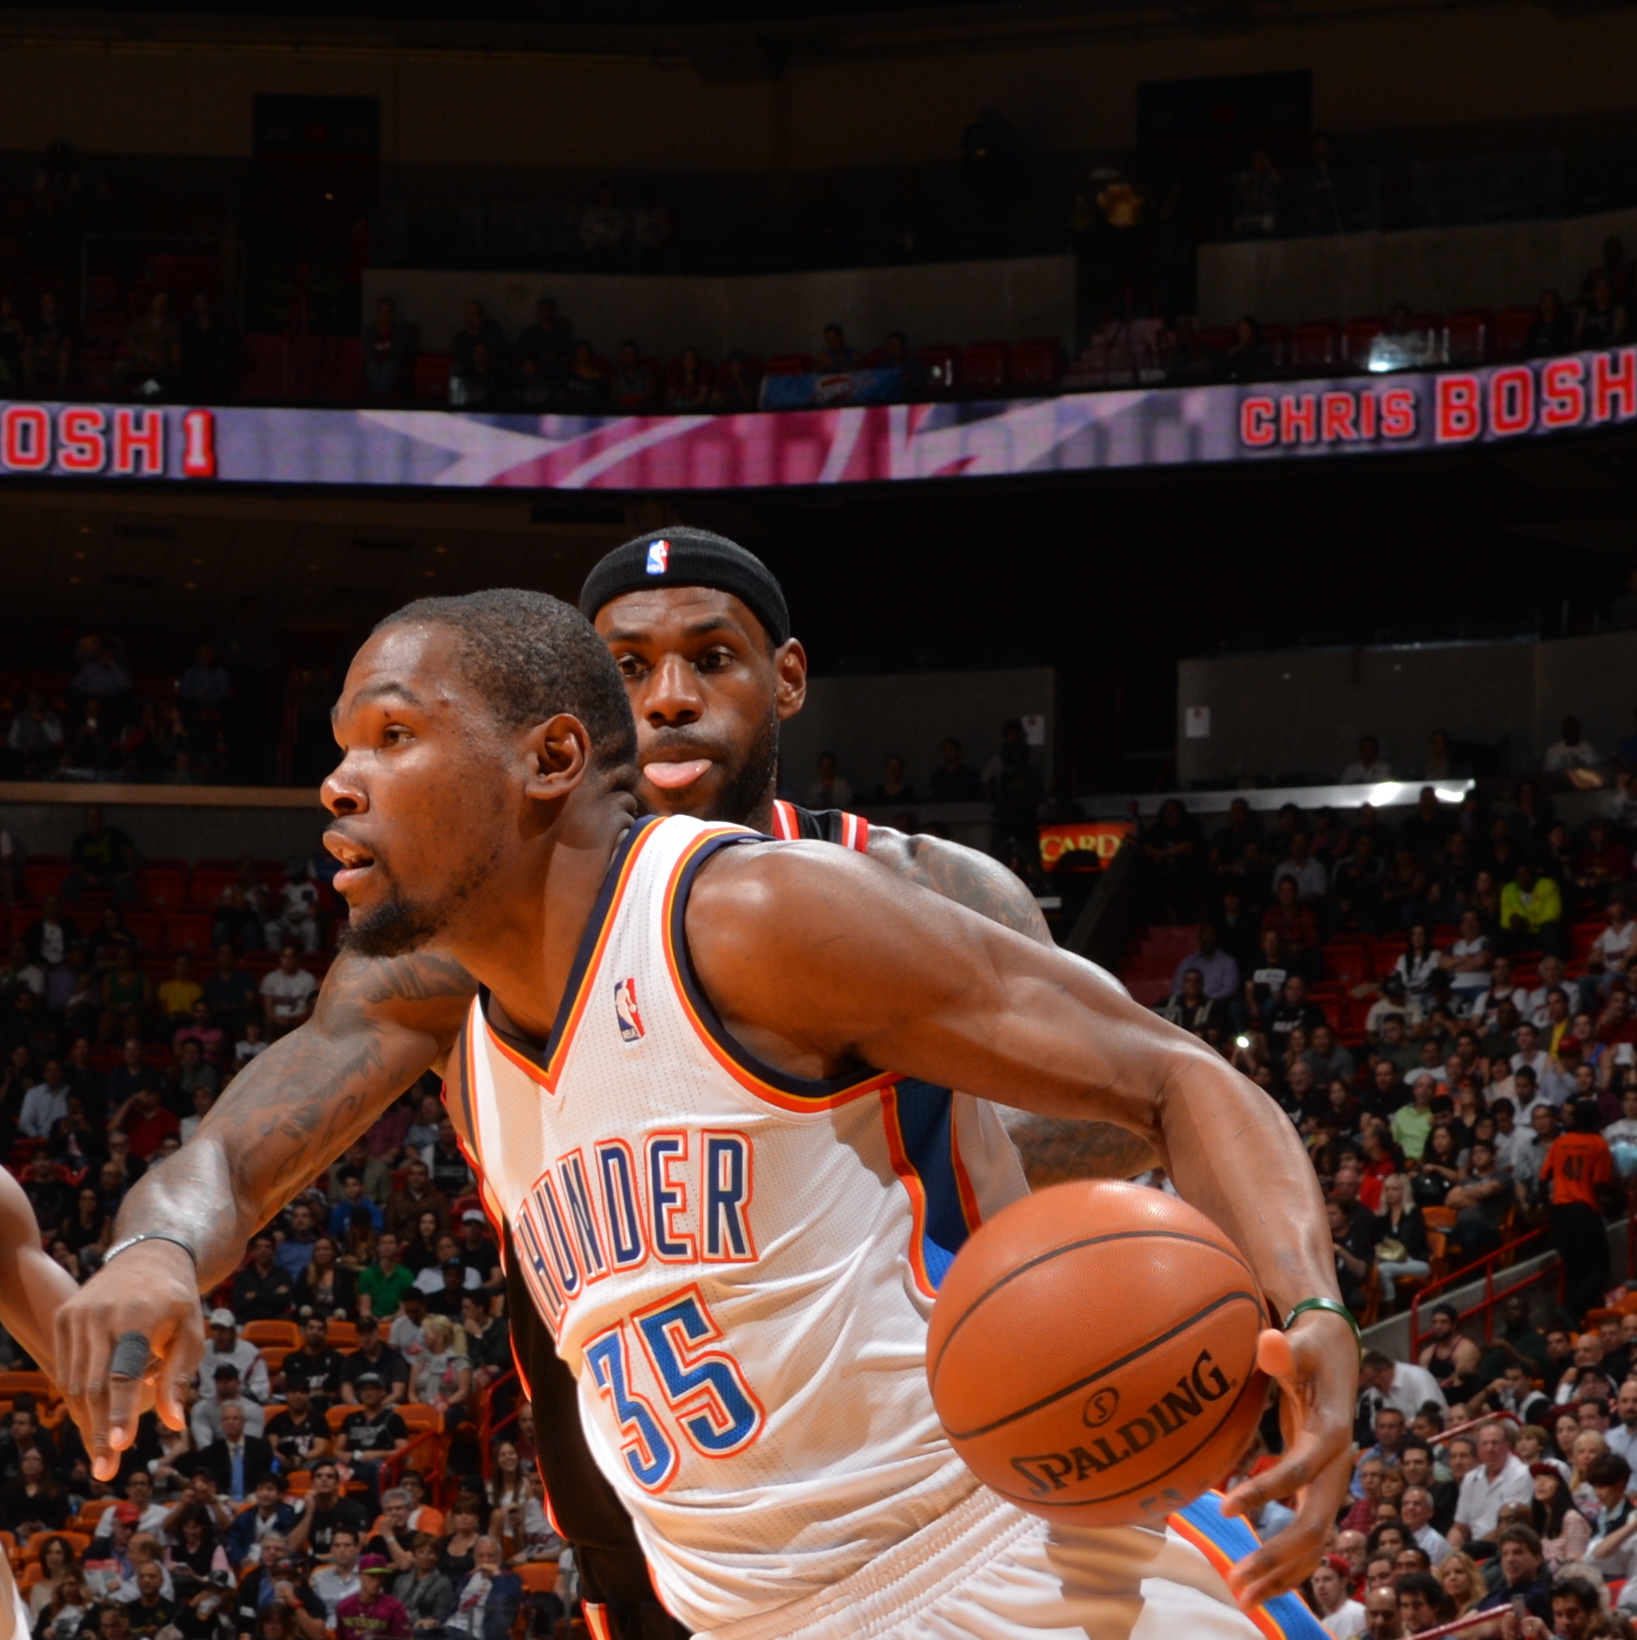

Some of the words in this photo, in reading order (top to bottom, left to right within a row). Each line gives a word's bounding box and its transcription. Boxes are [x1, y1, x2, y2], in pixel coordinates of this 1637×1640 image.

[183, 409, 216, 478] 1
[1239, 388, 1417, 447] CHRIS
[1038, 833, 1122, 862] CARD
[582, 1282, 766, 1495] 35
[1010, 1348, 1232, 1497] SPALDING
